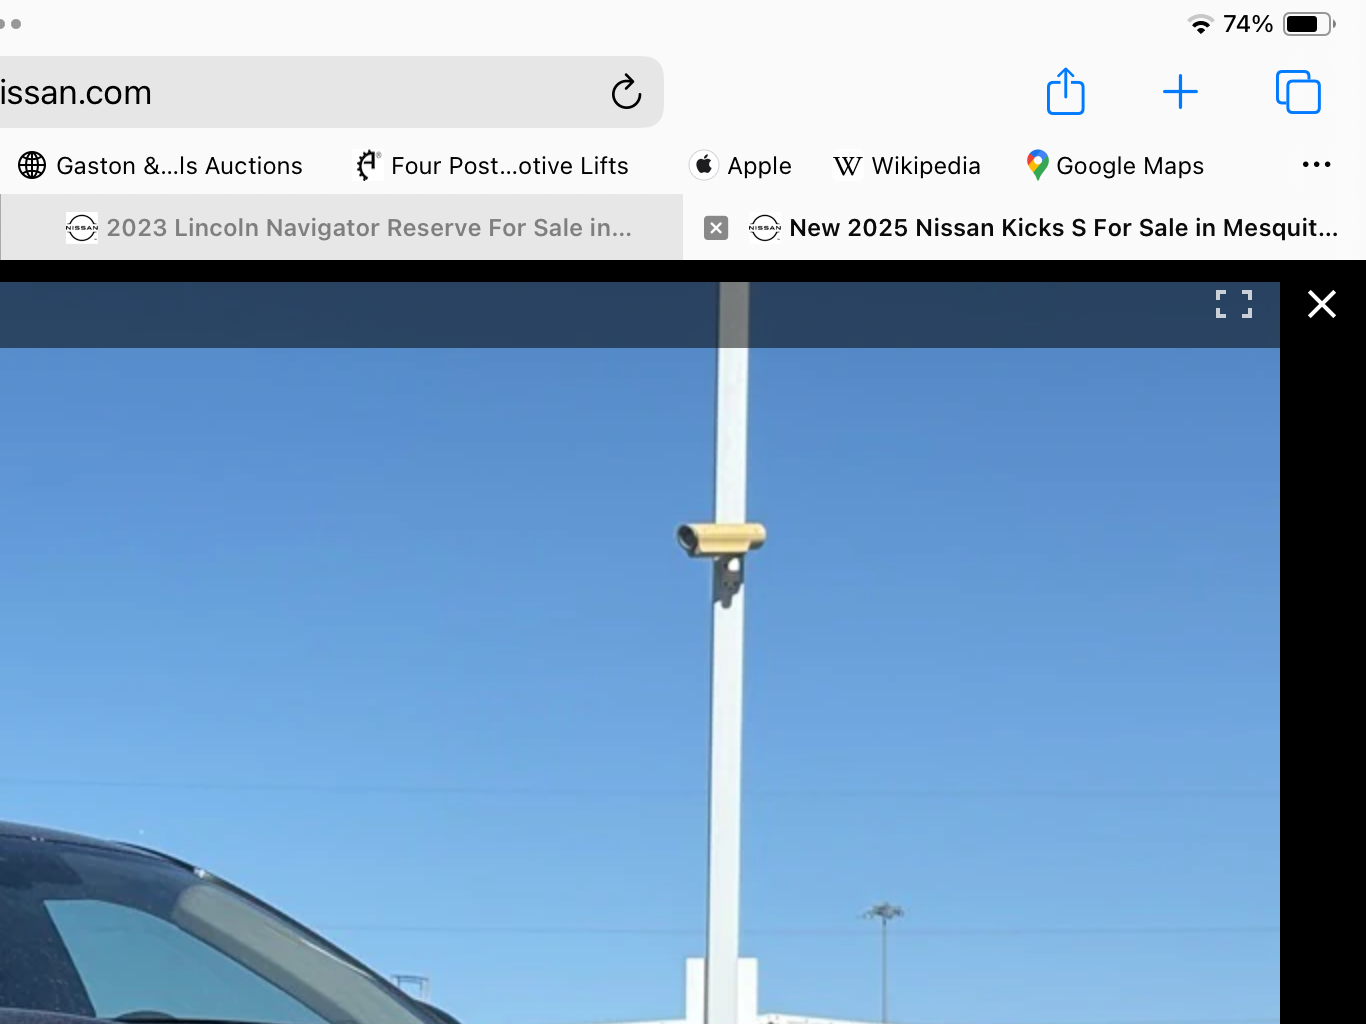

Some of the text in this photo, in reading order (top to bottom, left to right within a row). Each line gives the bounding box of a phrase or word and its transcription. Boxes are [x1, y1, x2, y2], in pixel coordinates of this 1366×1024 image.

[1223, 14, 1274, 33] 74%
[56, 155, 136, 176] Gaston
[204, 155, 303, 176] Auctions
[392, 156, 442, 176] Four
[581, 155, 629, 176] Lifts
[727, 155, 792, 180] Apple
[871, 155, 981, 180] Wikipedia
[1056, 155, 1205, 180] Google Maps
[107, 218, 167, 238] 2023
[175, 217, 259, 237] Lincoln
[266, 217, 381, 242] Navigator
[387, 218, 482, 237] Reserve
[489, 218, 527, 237] For
[533, 217, 583, 238] Sale
[790, 218, 841, 238] New
[847, 217, 908, 238] 2025
[916, 216, 994, 238] Nissan
[1002, 216, 1065, 238] Kicks
[1071, 217, 1087, 238] S
[1094, 218, 1133, 238] For
[1139, 217, 1189, 238] Sale
[1195, 216, 1216, 237] in
